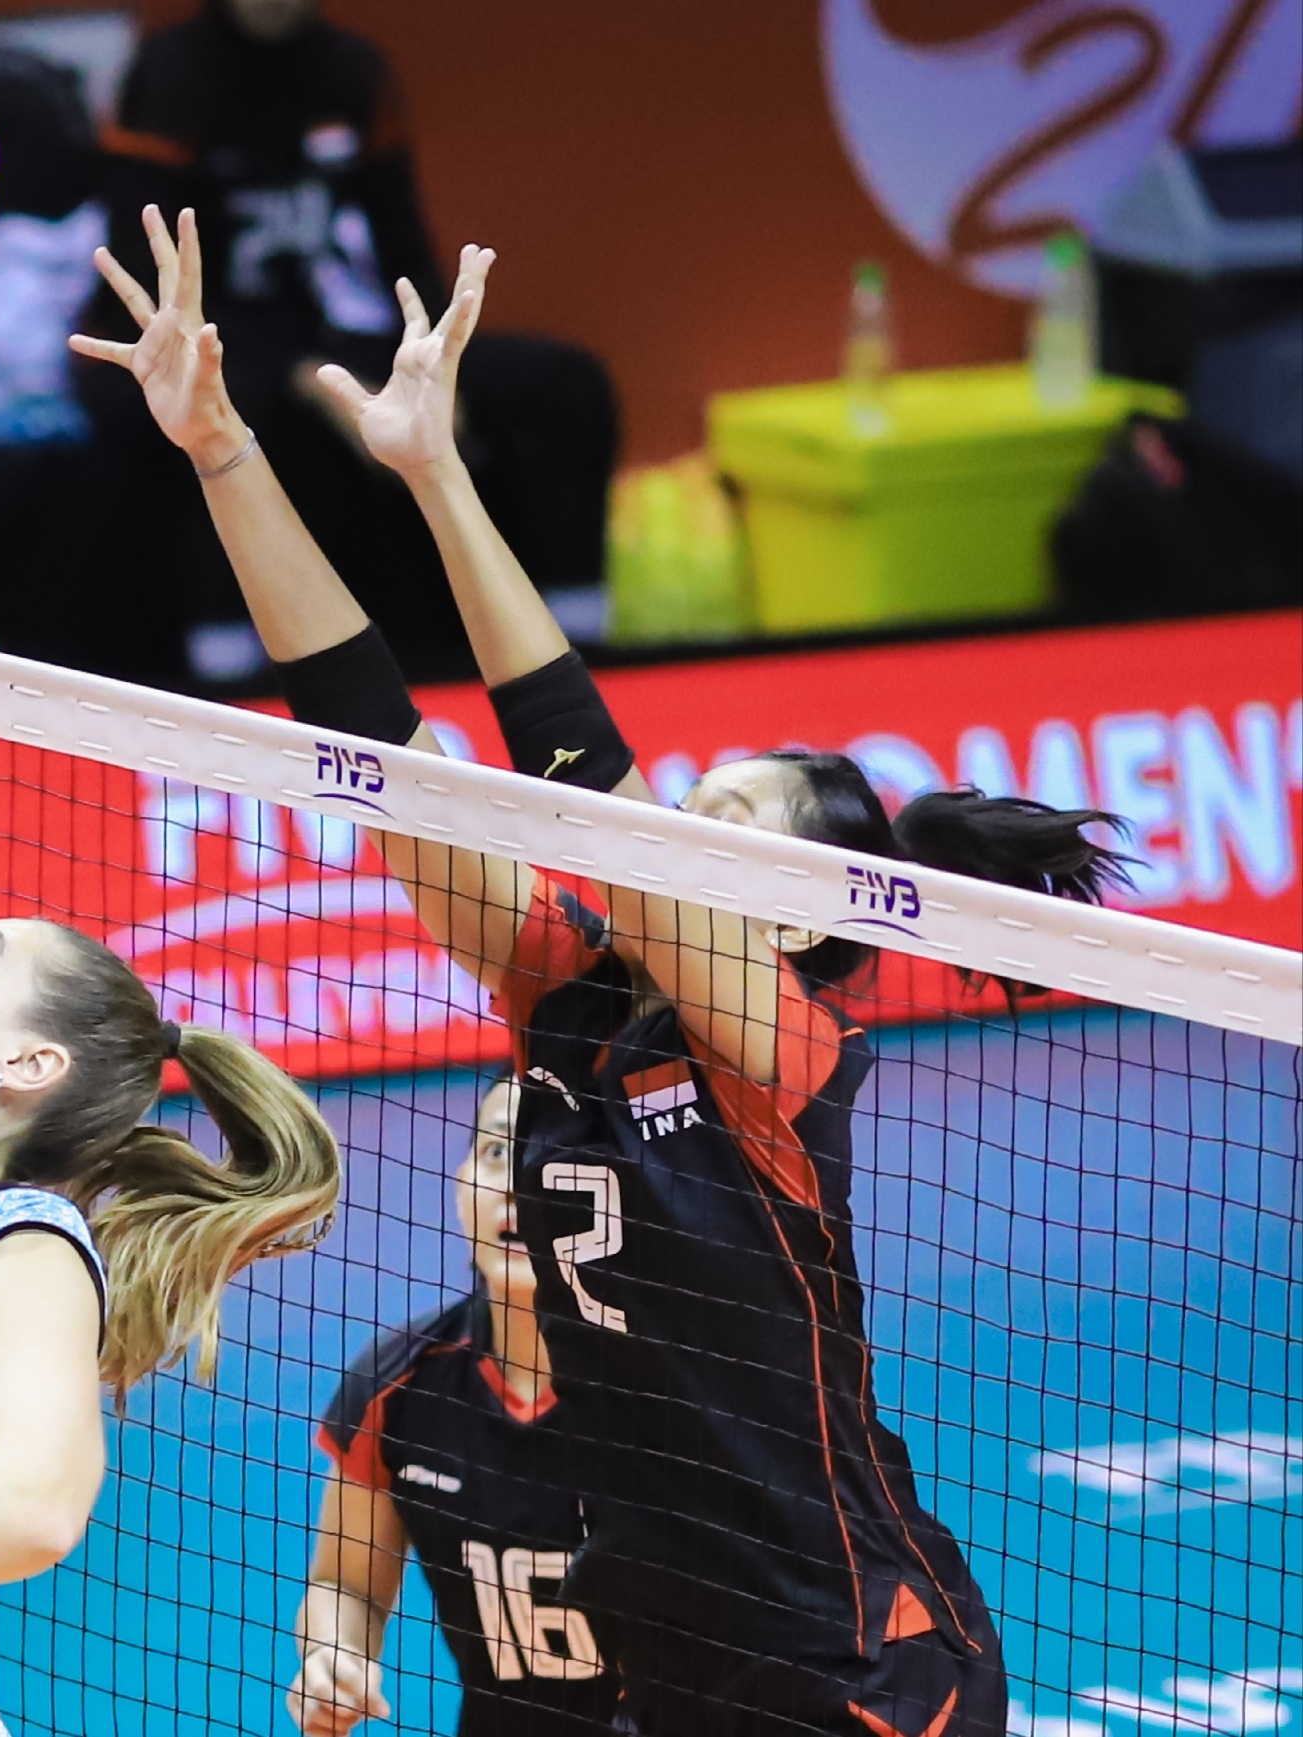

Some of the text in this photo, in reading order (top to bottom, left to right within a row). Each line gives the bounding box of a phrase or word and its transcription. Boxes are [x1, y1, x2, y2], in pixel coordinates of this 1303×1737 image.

[314, 742, 386, 793] FIVB
[847, 866, 921, 919] FIVB
[639, 1106, 705, 1142] INA
[541, 1162, 628, 1334] 2
[460, 1539, 605, 1681] 16
